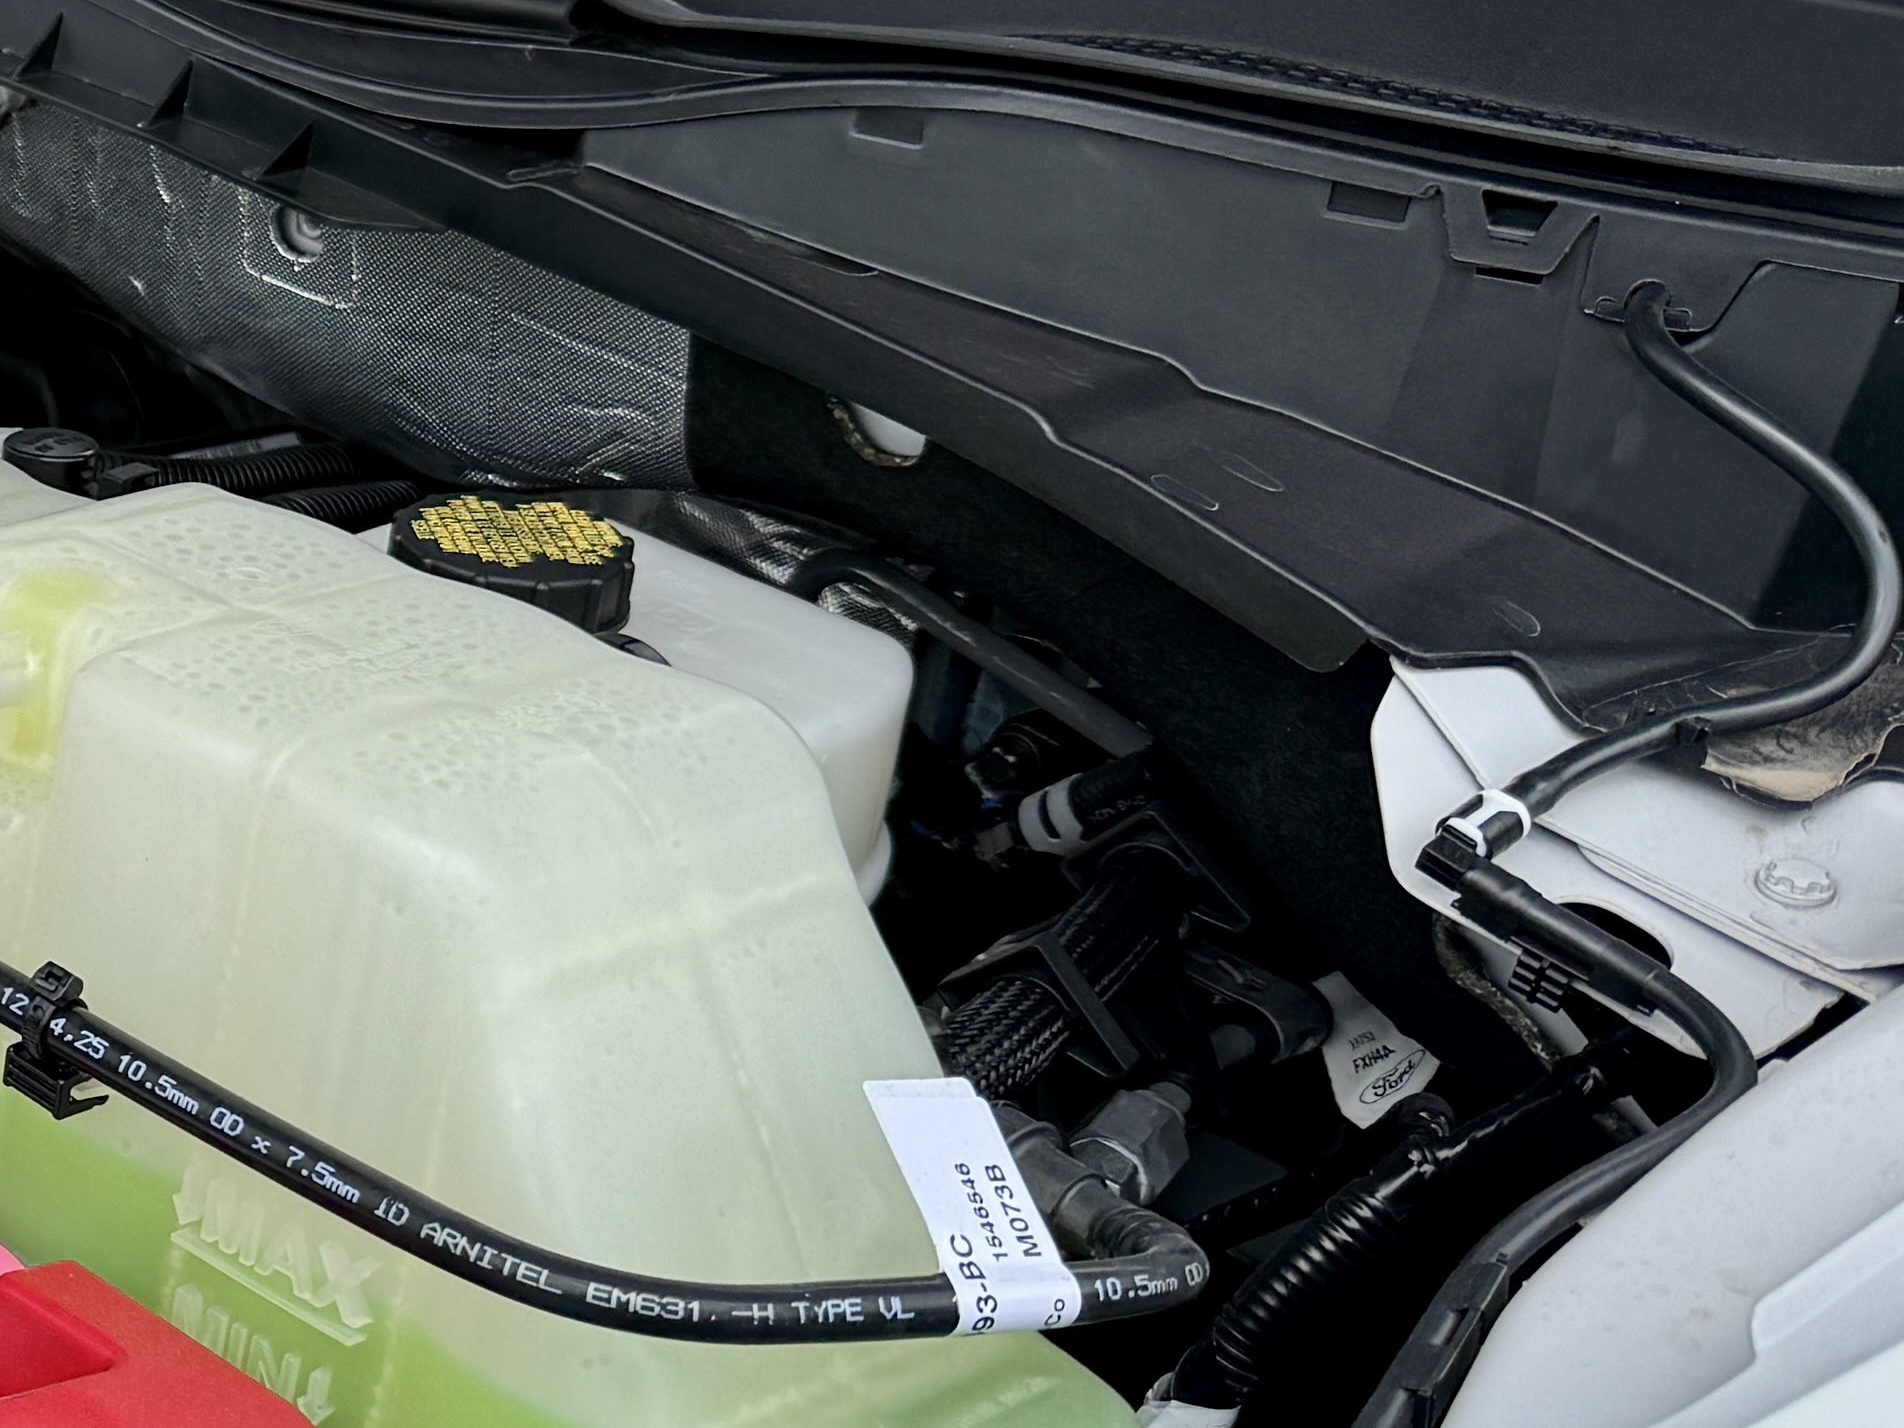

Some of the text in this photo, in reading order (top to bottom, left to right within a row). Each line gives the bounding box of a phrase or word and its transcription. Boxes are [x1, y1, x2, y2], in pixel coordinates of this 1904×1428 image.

[1, 986, 108, 1060] 124.25
[1372, 1060, 1417, 1097] Ford
[117, 1052, 200, 1116] 10.5mm
[285, 1145, 361, 1203] 7.5mm
[420, 1222, 563, 1294] ARNITEL
[791, 1299, 865, 1324] TYPE
[1093, 1271, 1179, 1303] 10.5mm
[985, 1164, 1041, 1258] M073B
[200, 1176, 384, 1329] MAX
[958, 1235, 1000, 1336] 93-BC
[173, 1284, 302, 1409] MIN
